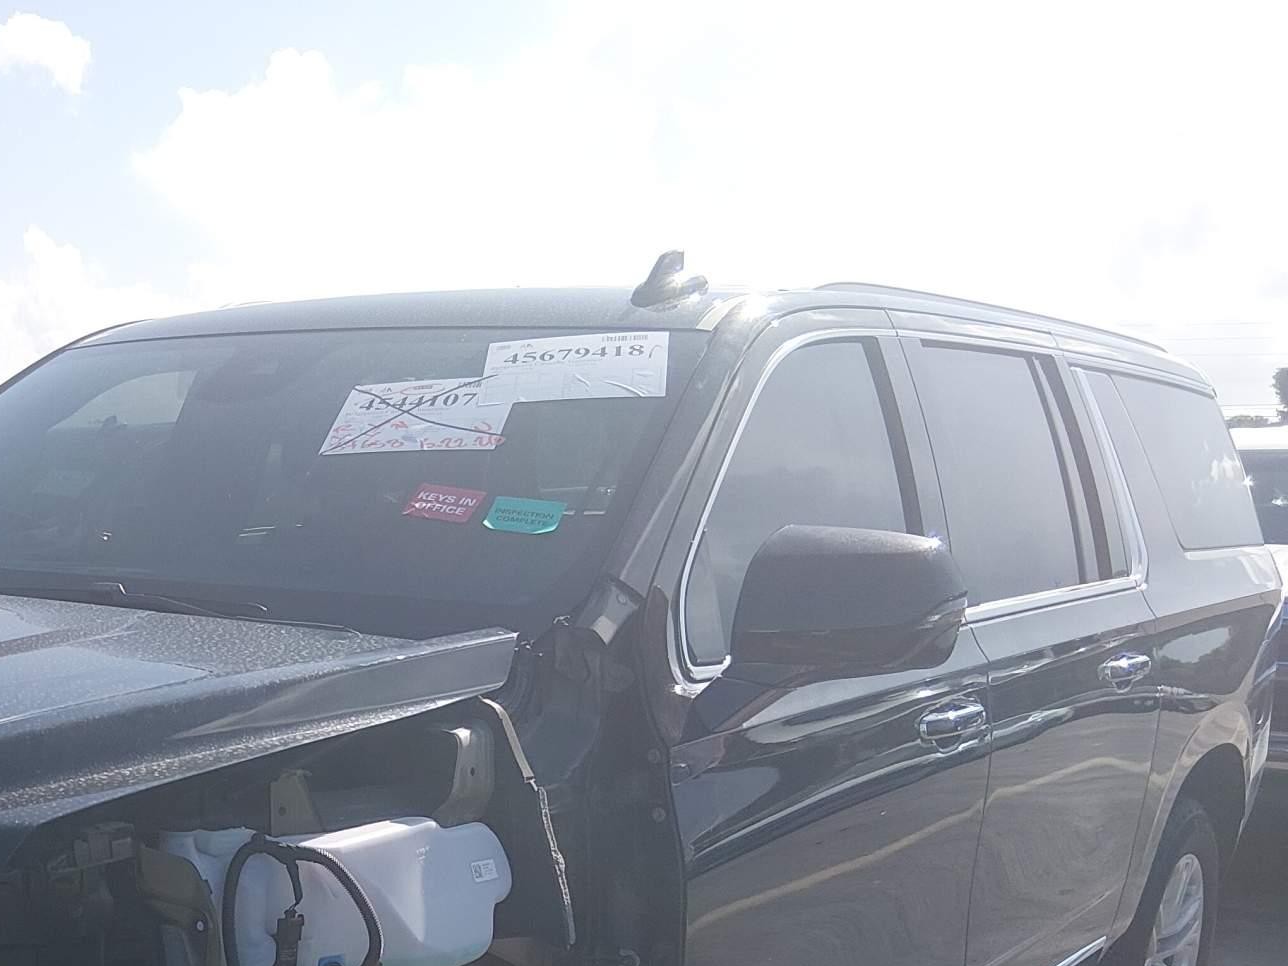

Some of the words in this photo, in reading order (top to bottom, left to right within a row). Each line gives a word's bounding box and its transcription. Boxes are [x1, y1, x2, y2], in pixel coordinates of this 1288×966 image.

[503, 343, 645, 365] 45679418
[417, 491, 456, 504] KEYS
[460, 496, 477, 507] IN
[415, 501, 466, 516] OFFICE
